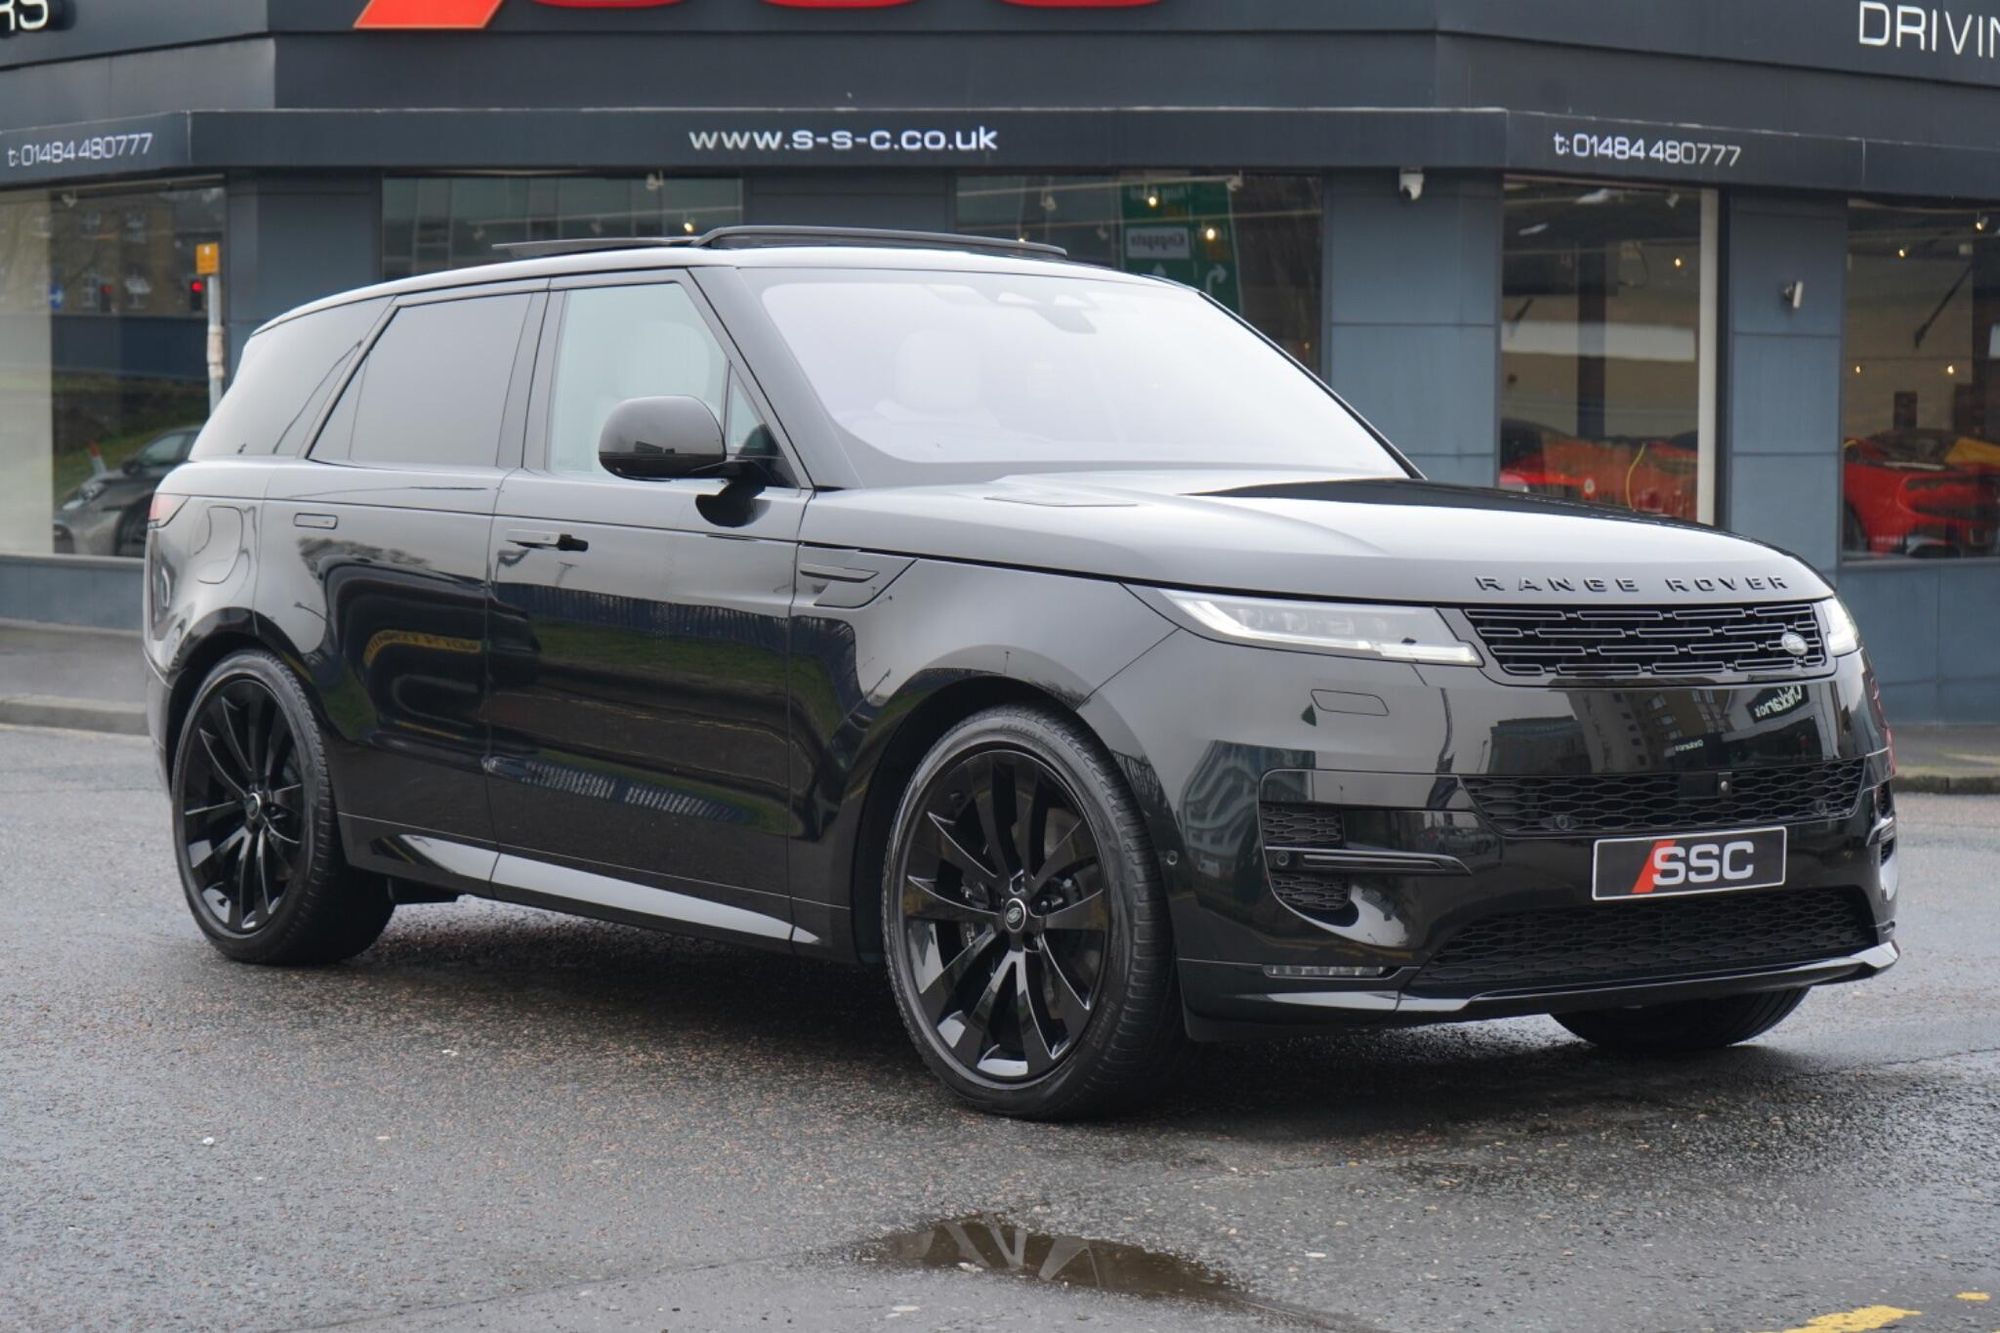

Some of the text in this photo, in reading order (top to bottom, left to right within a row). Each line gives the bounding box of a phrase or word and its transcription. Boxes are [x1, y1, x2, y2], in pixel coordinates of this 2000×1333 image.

[78, 132, 153, 160] 480777
[689, 126, 998, 150] www.s-s-c.co.uk
[1649, 140, 1741, 167] 480777
[1474, 575, 1788, 592] RANGE ROVER
[1652, 841, 1754, 886] SSC
